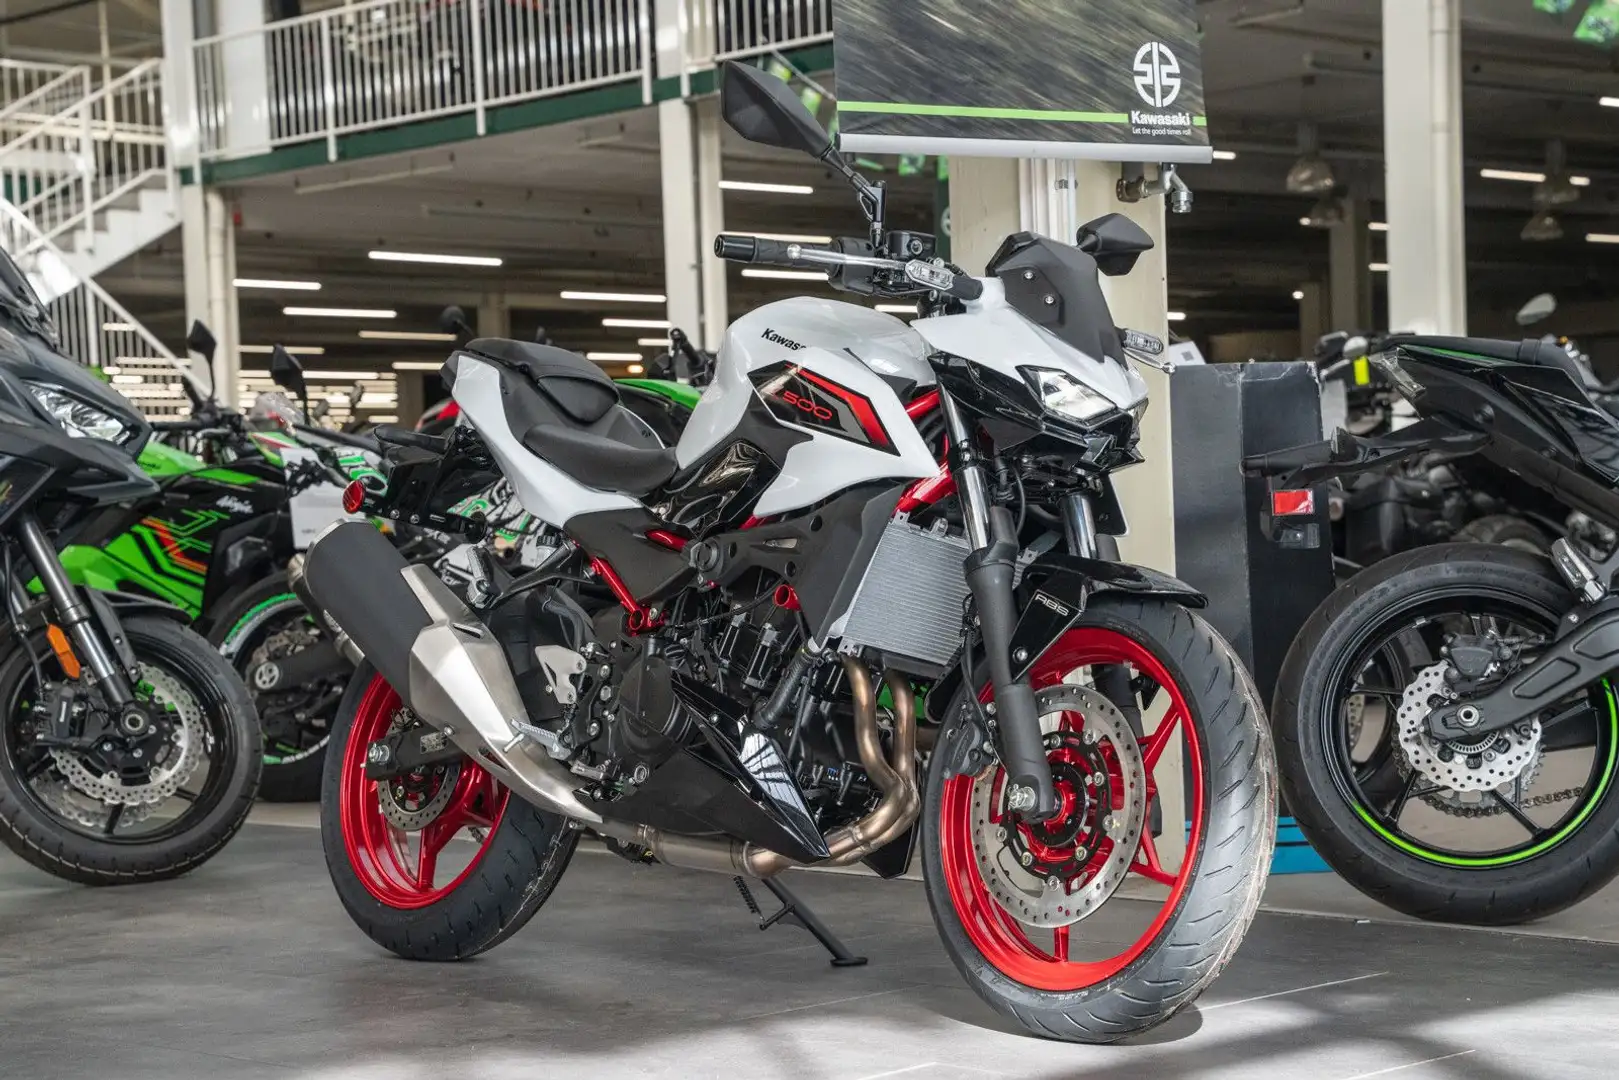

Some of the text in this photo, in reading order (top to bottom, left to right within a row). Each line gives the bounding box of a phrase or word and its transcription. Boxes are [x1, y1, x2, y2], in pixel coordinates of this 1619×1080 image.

[1131, 110, 1191, 126] Kawasaki
[1152, 128, 1166, 136] good
[1035, 594, 1069, 617] ABS
